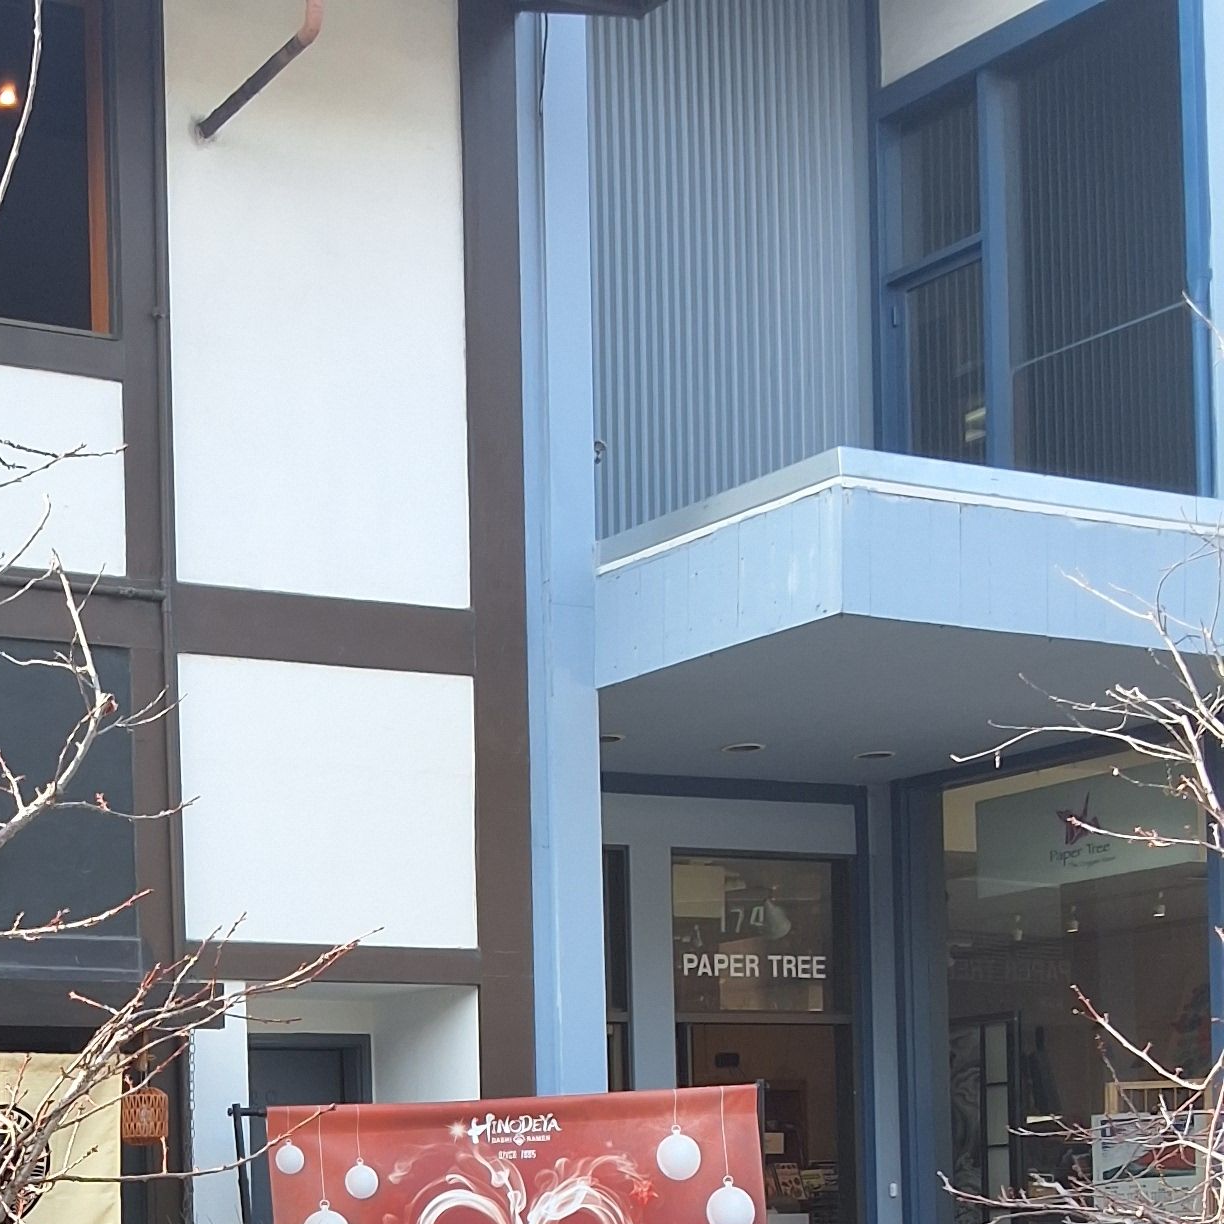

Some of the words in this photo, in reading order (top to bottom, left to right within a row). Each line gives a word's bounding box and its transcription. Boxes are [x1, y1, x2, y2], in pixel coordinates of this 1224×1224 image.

[683, 953, 760, 978] PAPER
[767, 955, 827, 979] TREE
[468, 1112, 563, 1144] HINODEYA
